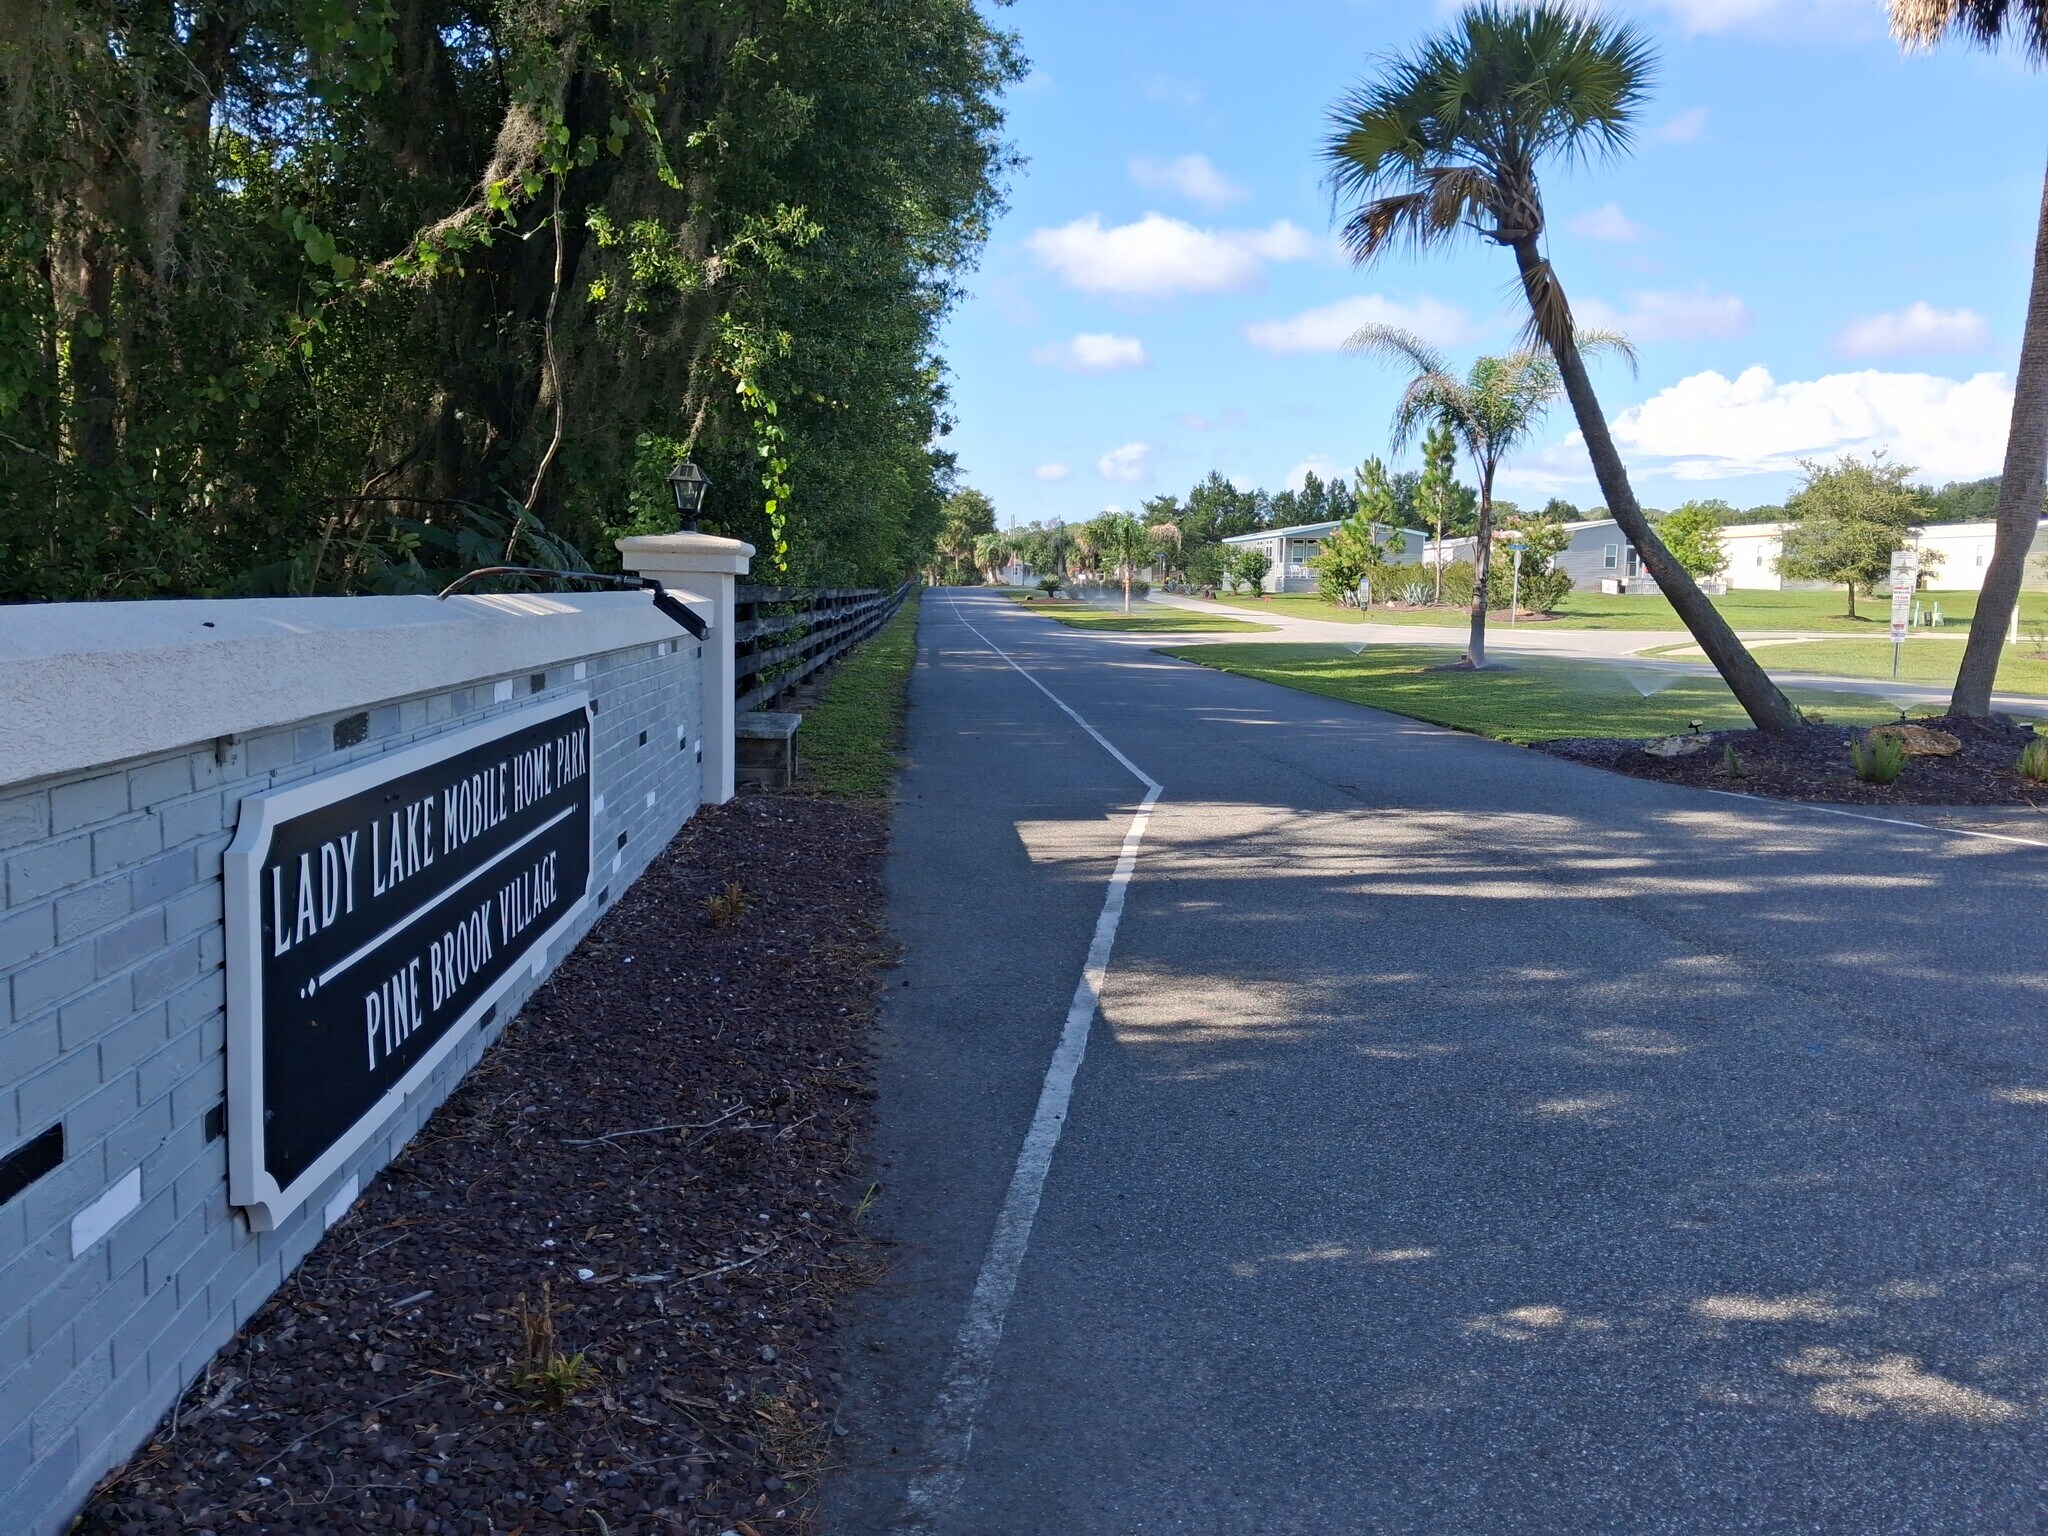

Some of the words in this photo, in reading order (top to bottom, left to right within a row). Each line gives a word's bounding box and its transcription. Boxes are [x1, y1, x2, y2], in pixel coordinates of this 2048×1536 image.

[272, 830, 358, 957] LADY
[372, 796, 434, 897] LAKE
[443, 762, 507, 855] MOBILE
[514, 742, 552, 813] HOME
[557, 727, 587, 788] PARK
[365, 956, 422, 1072] PINE
[430, 900, 493, 1012] BROOK
[499, 850, 557, 946] VILLAGE
